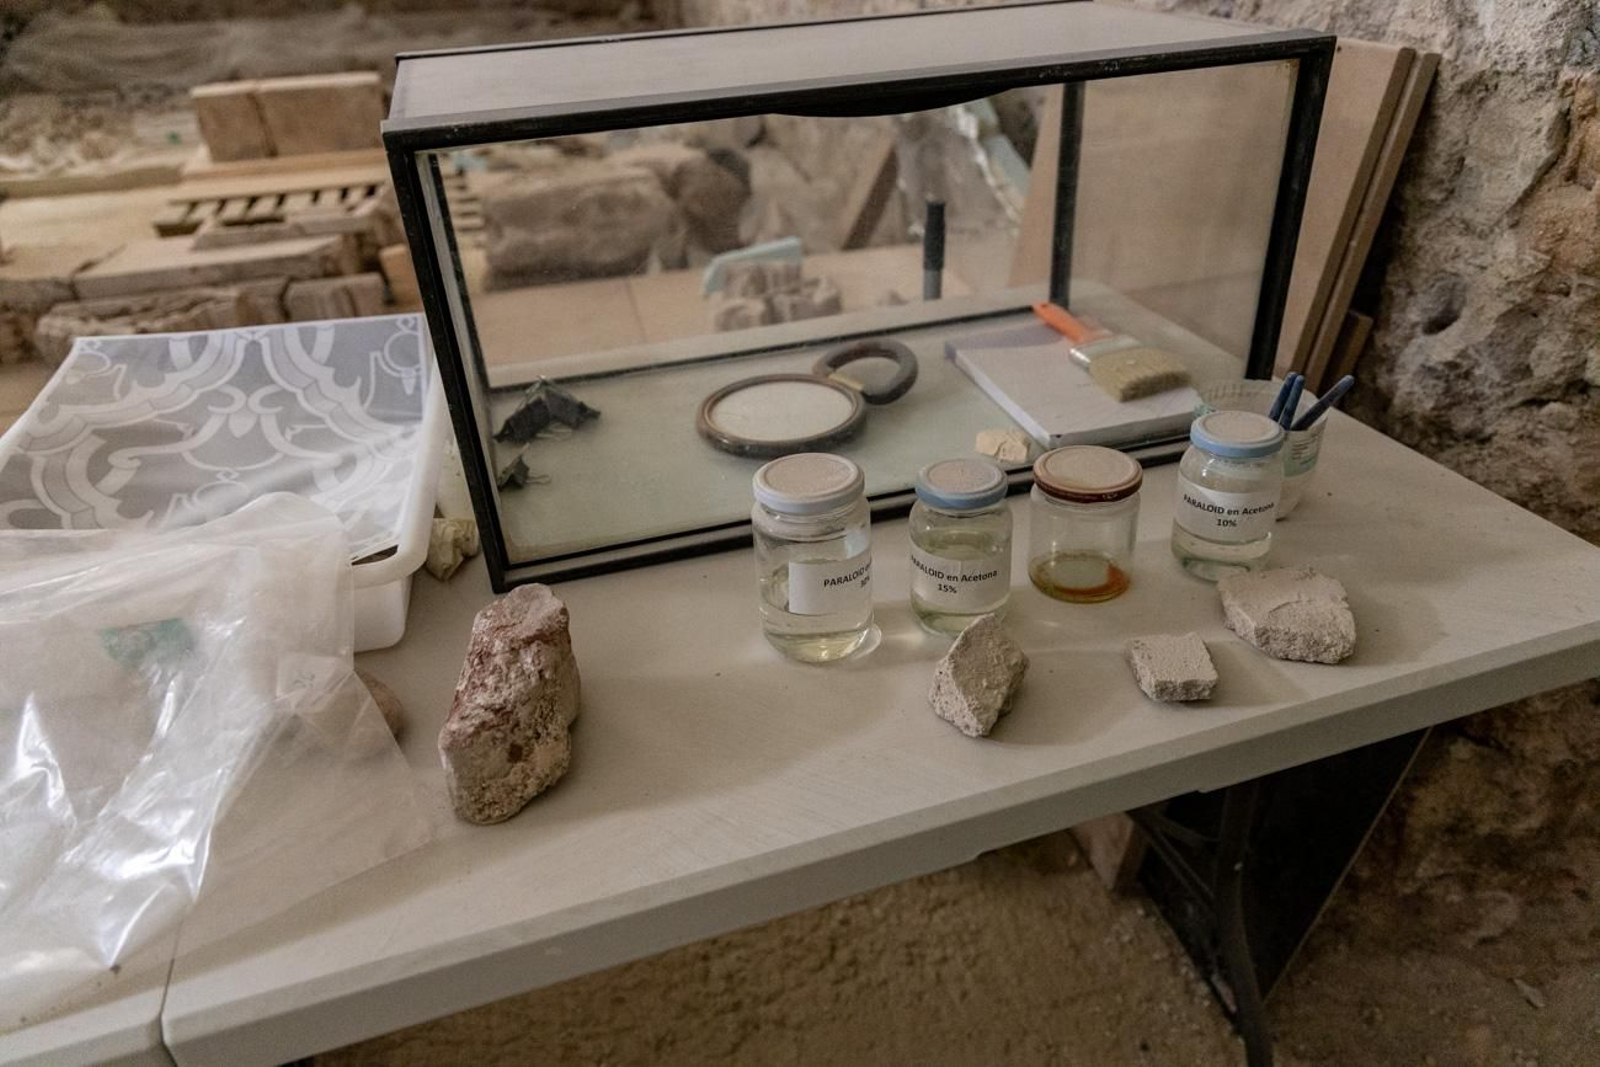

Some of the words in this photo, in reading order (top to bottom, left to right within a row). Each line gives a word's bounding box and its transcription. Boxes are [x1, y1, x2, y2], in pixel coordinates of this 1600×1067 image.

[1183, 494, 1225, 514] PARALOID
[1227, 507, 1239, 515] en
[1217, 519, 1237, 527] 10%
[823, 567, 864, 587] PARALOID
[946, 574, 959, 582] en
[961, 570, 998, 582] Acetona
[938, 583, 957, 594] 15%
